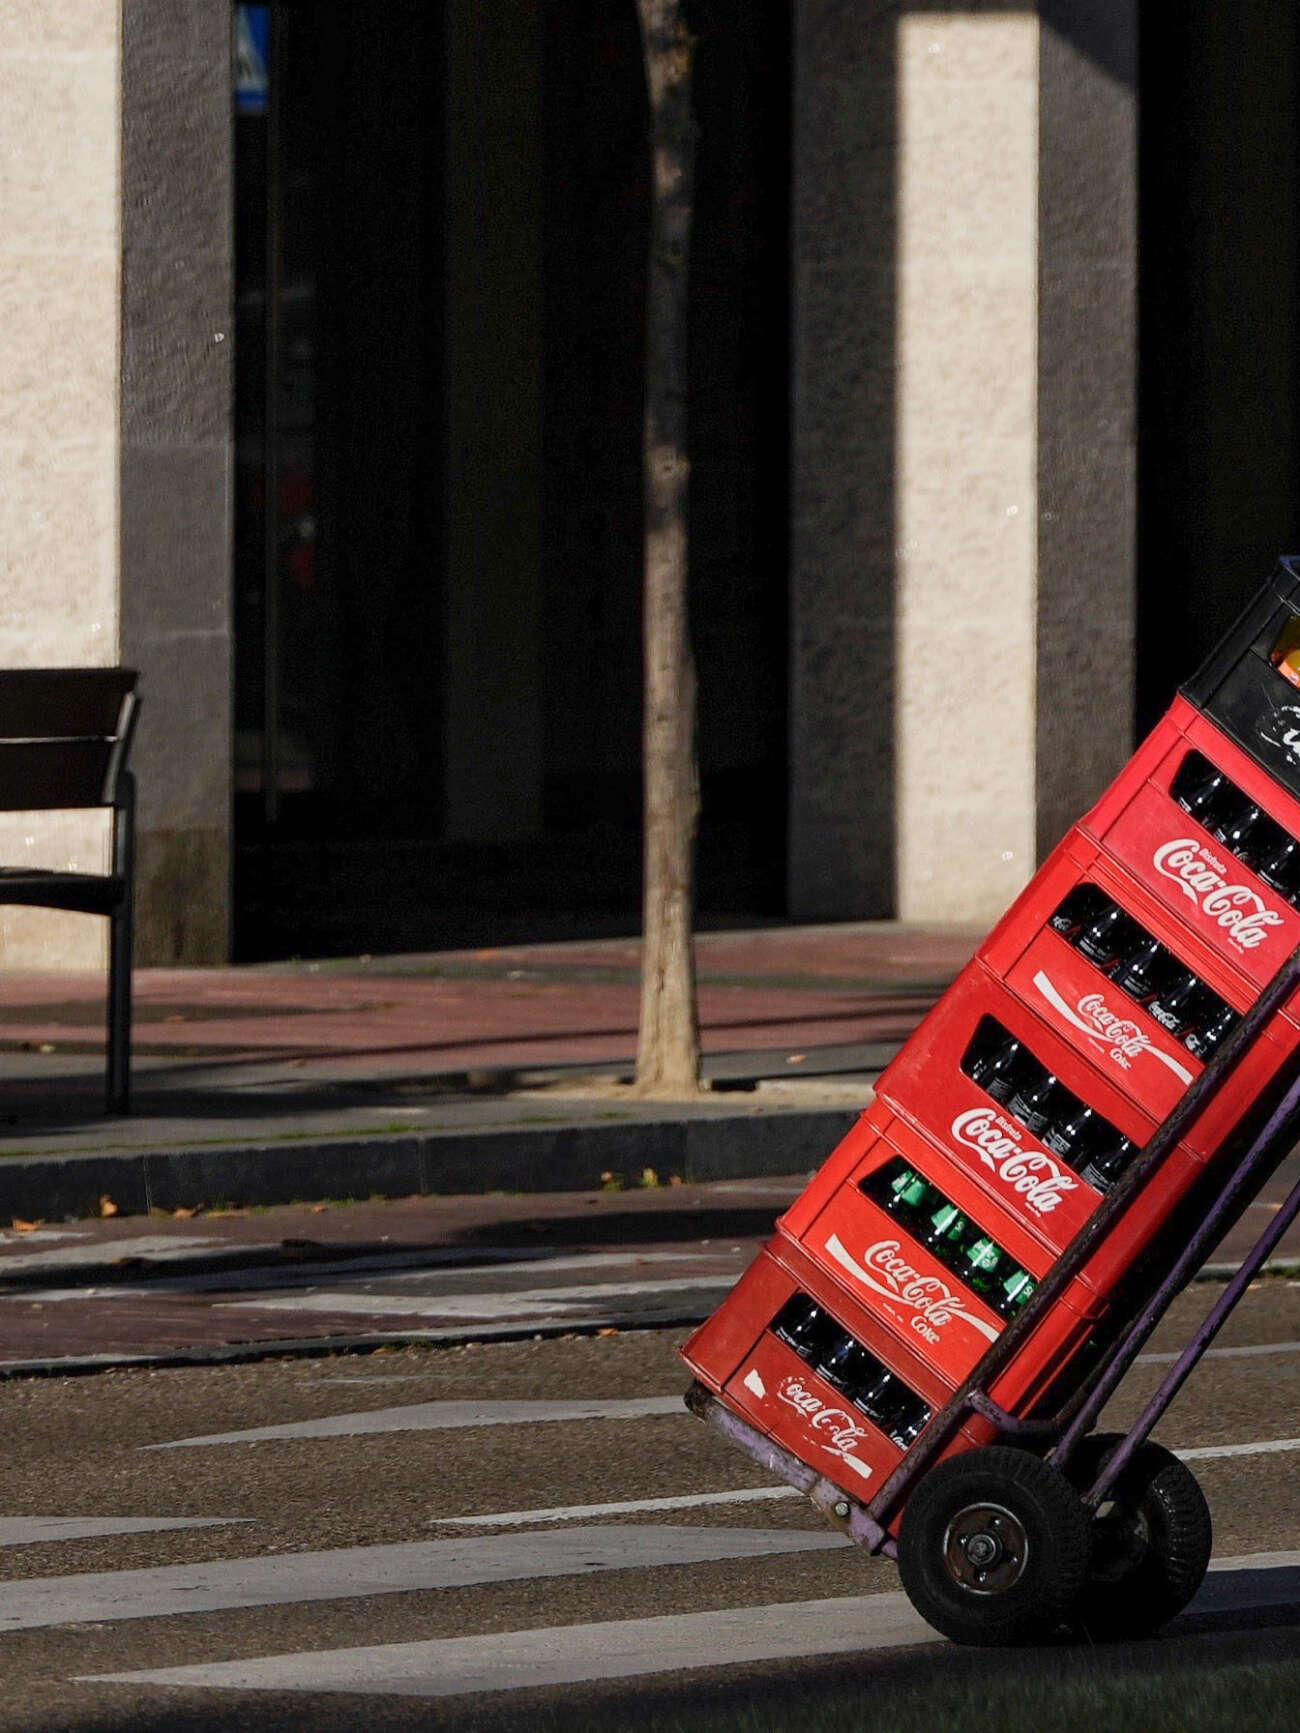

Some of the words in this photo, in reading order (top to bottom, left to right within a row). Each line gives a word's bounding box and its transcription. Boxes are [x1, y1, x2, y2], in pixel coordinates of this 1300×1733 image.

[1153, 838, 1284, 950] Coca-Cola
[1077, 994, 1152, 1057] Coca-Cola
[951, 1107, 1080, 1213] Coca-Cola
[864, 1240, 966, 1327] Coca-Cola
[910, 1315, 941, 1345] Coke
